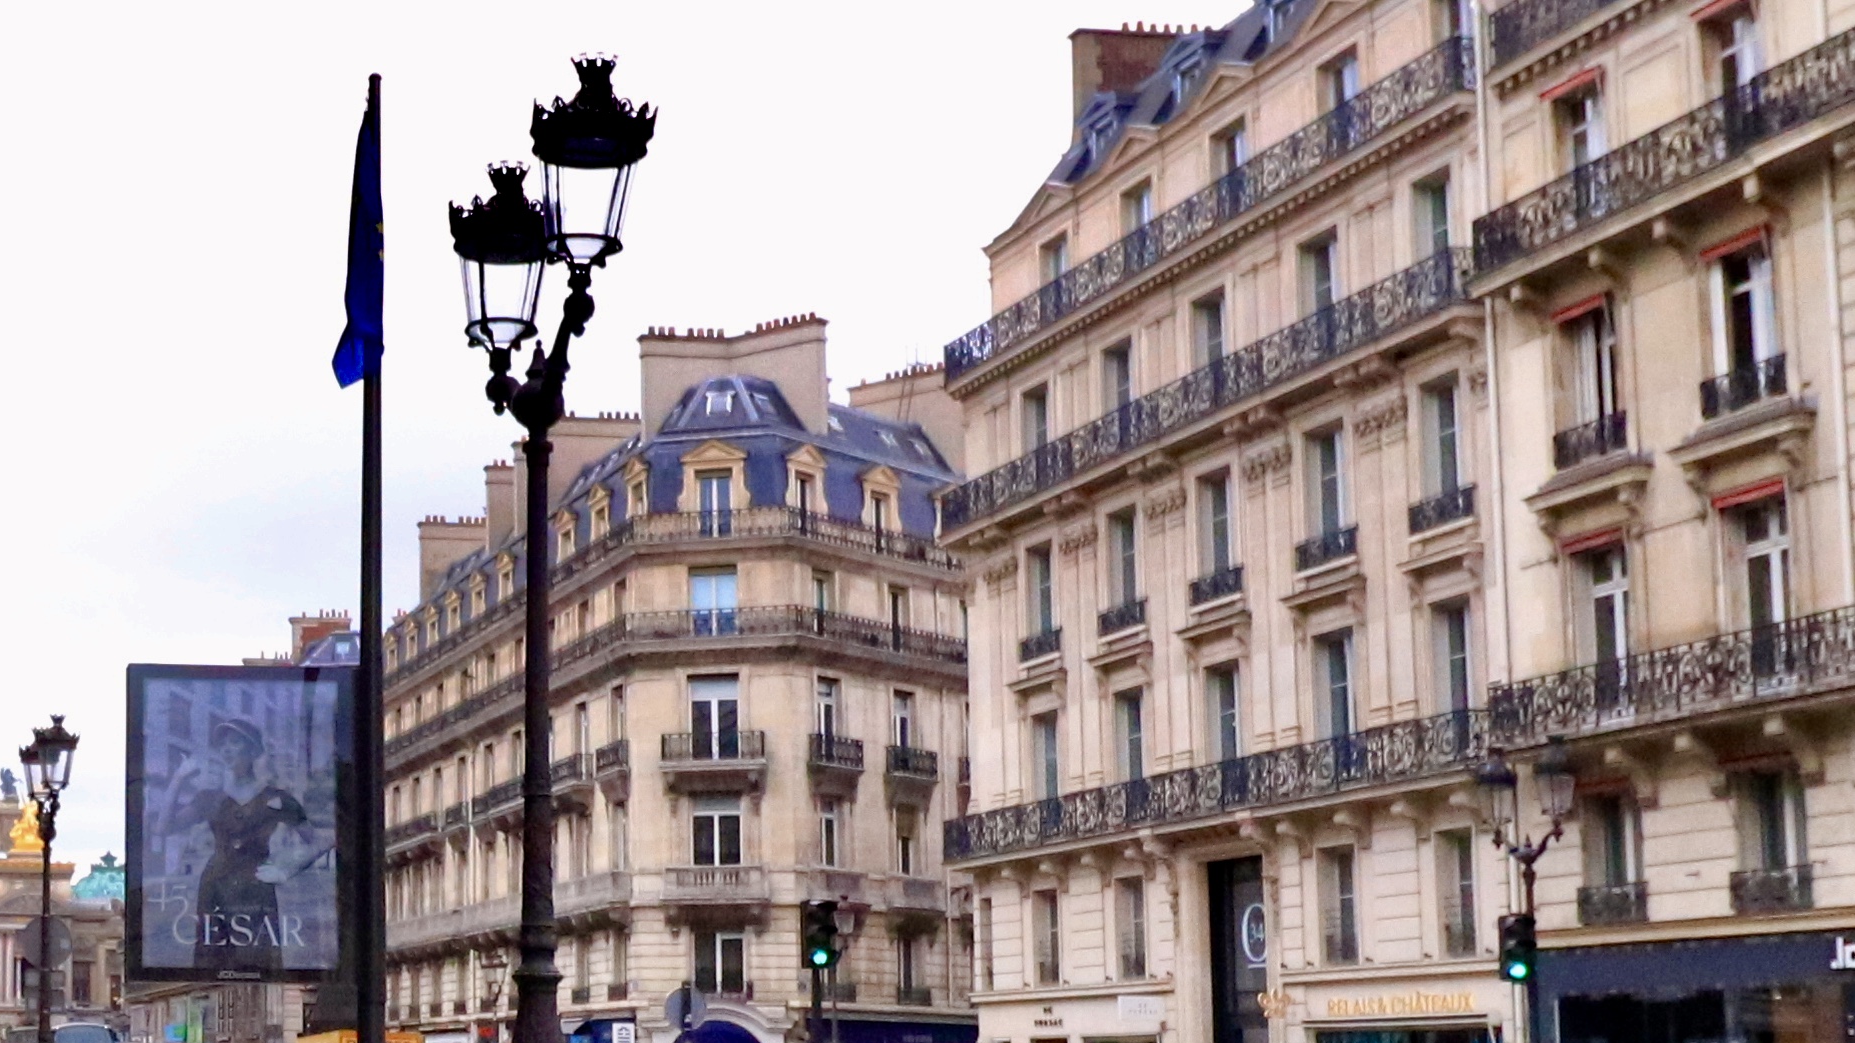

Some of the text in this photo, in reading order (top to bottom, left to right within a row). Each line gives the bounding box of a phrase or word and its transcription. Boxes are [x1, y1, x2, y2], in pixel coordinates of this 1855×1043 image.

[173, 907, 305, 947] CÉSAR
[1327, 998, 1376, 1017] RELAIS
[1391, 990, 1474, 1014] CHÂTEAUX
